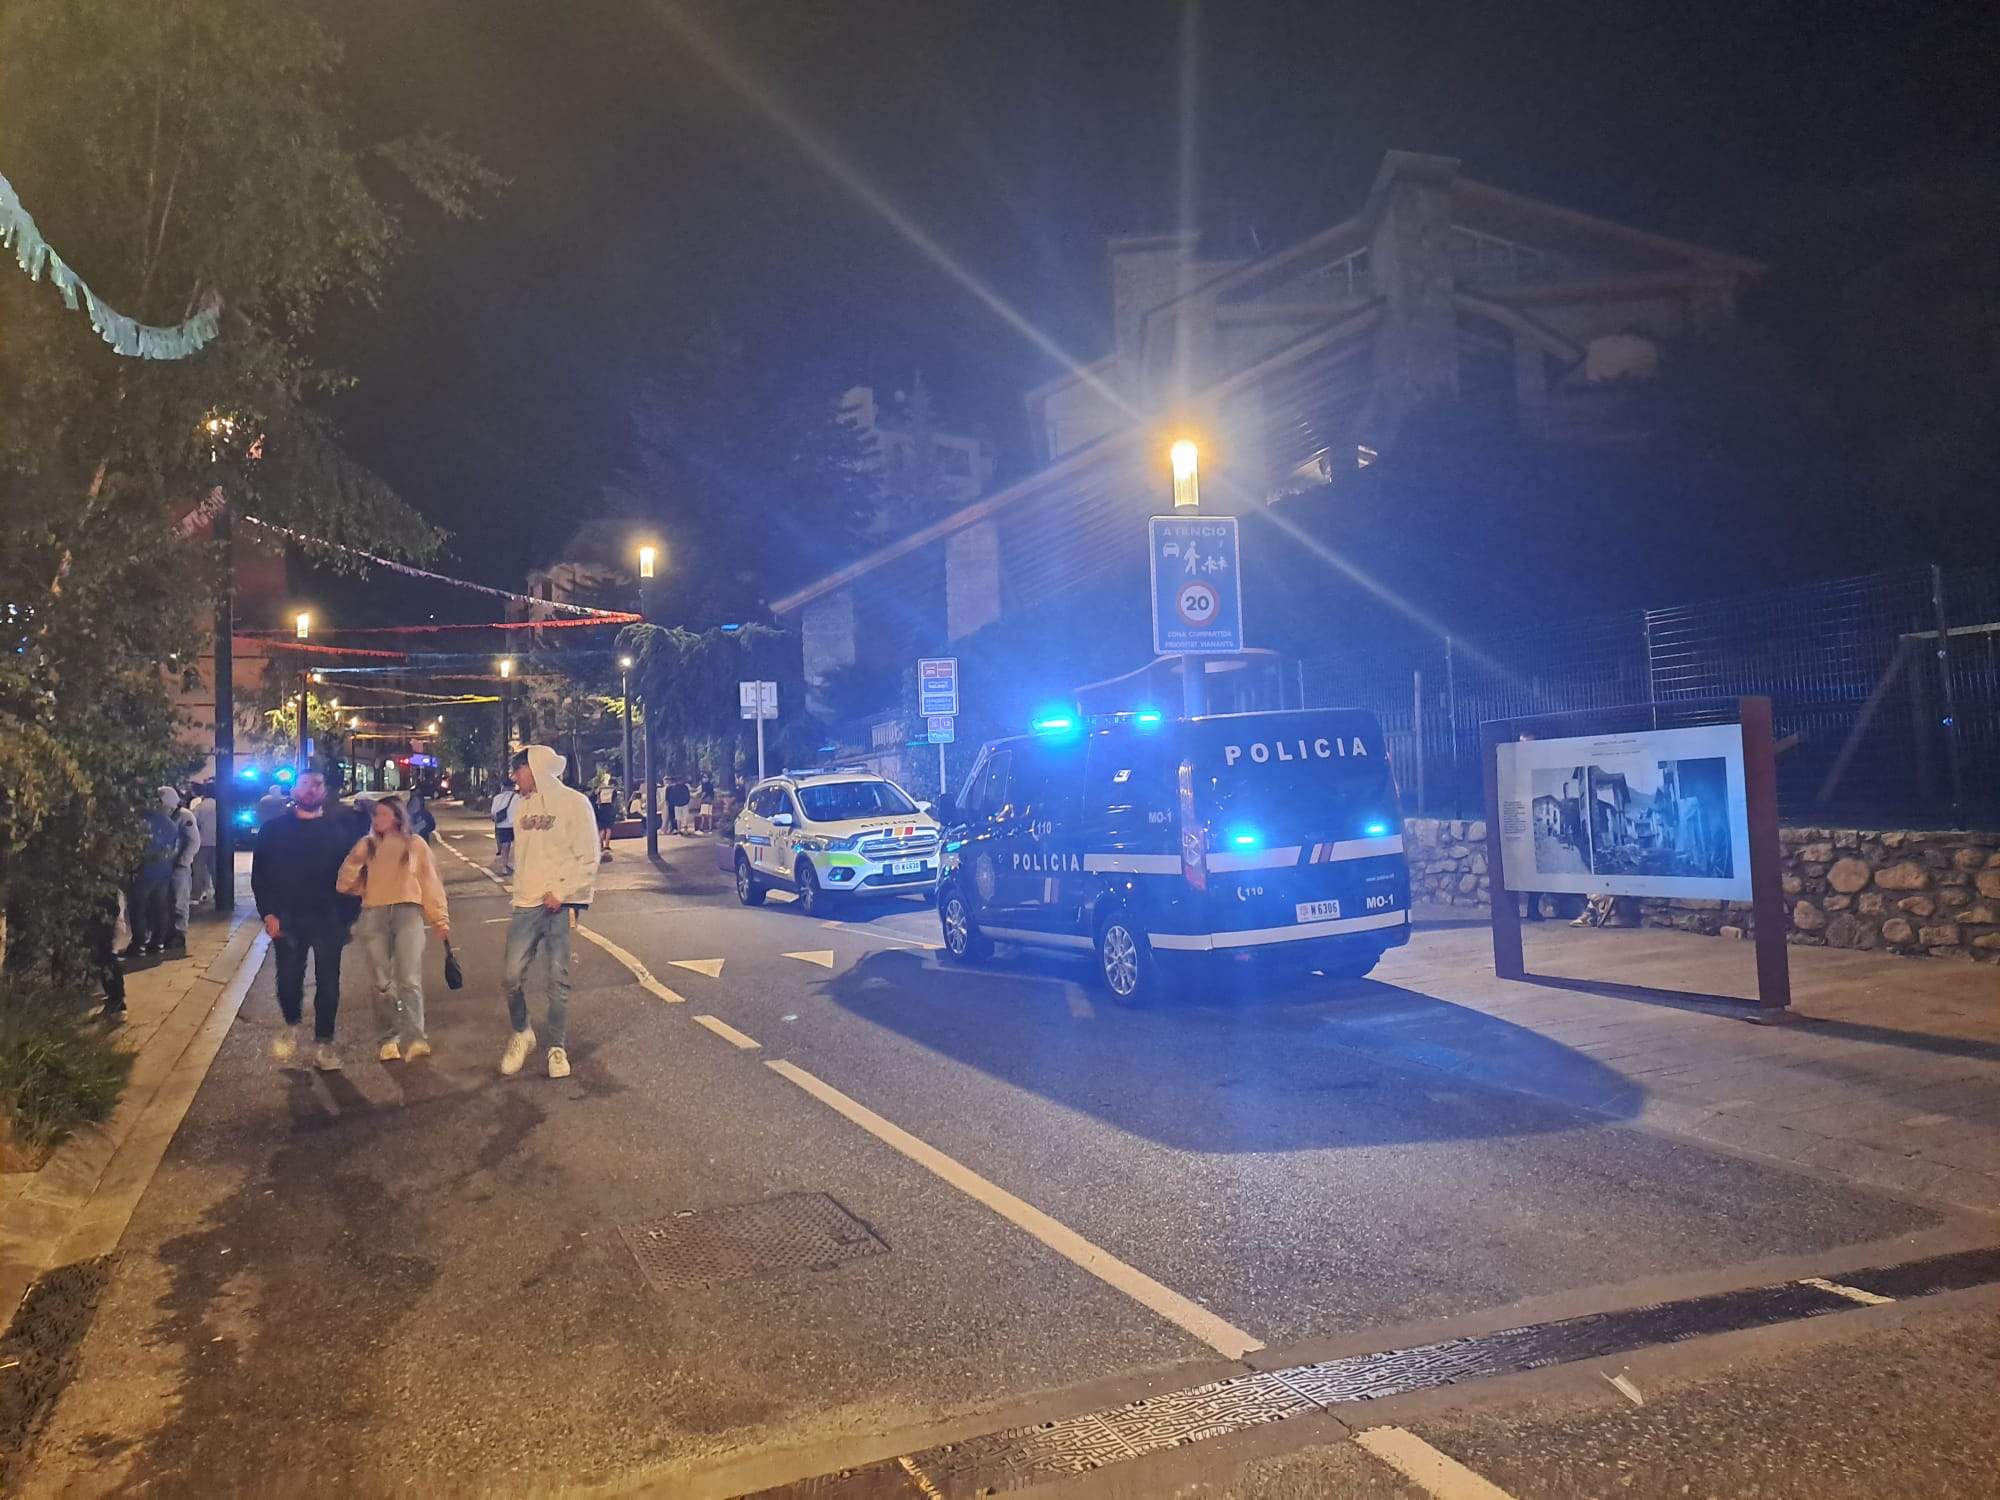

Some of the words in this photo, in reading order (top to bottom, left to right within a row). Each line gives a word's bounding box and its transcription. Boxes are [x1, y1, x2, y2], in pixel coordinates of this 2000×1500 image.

[1185, 596, 1210, 611] 20
[1224, 736, 1368, 766] POLICIA
[1148, 808, 1172, 824] MO-1
[1036, 821, 1052, 835] 110
[1013, 853, 1080, 872] POLICIA
[1244, 886, 1264, 897] 110
[1366, 894, 1394, 910] MO-1
